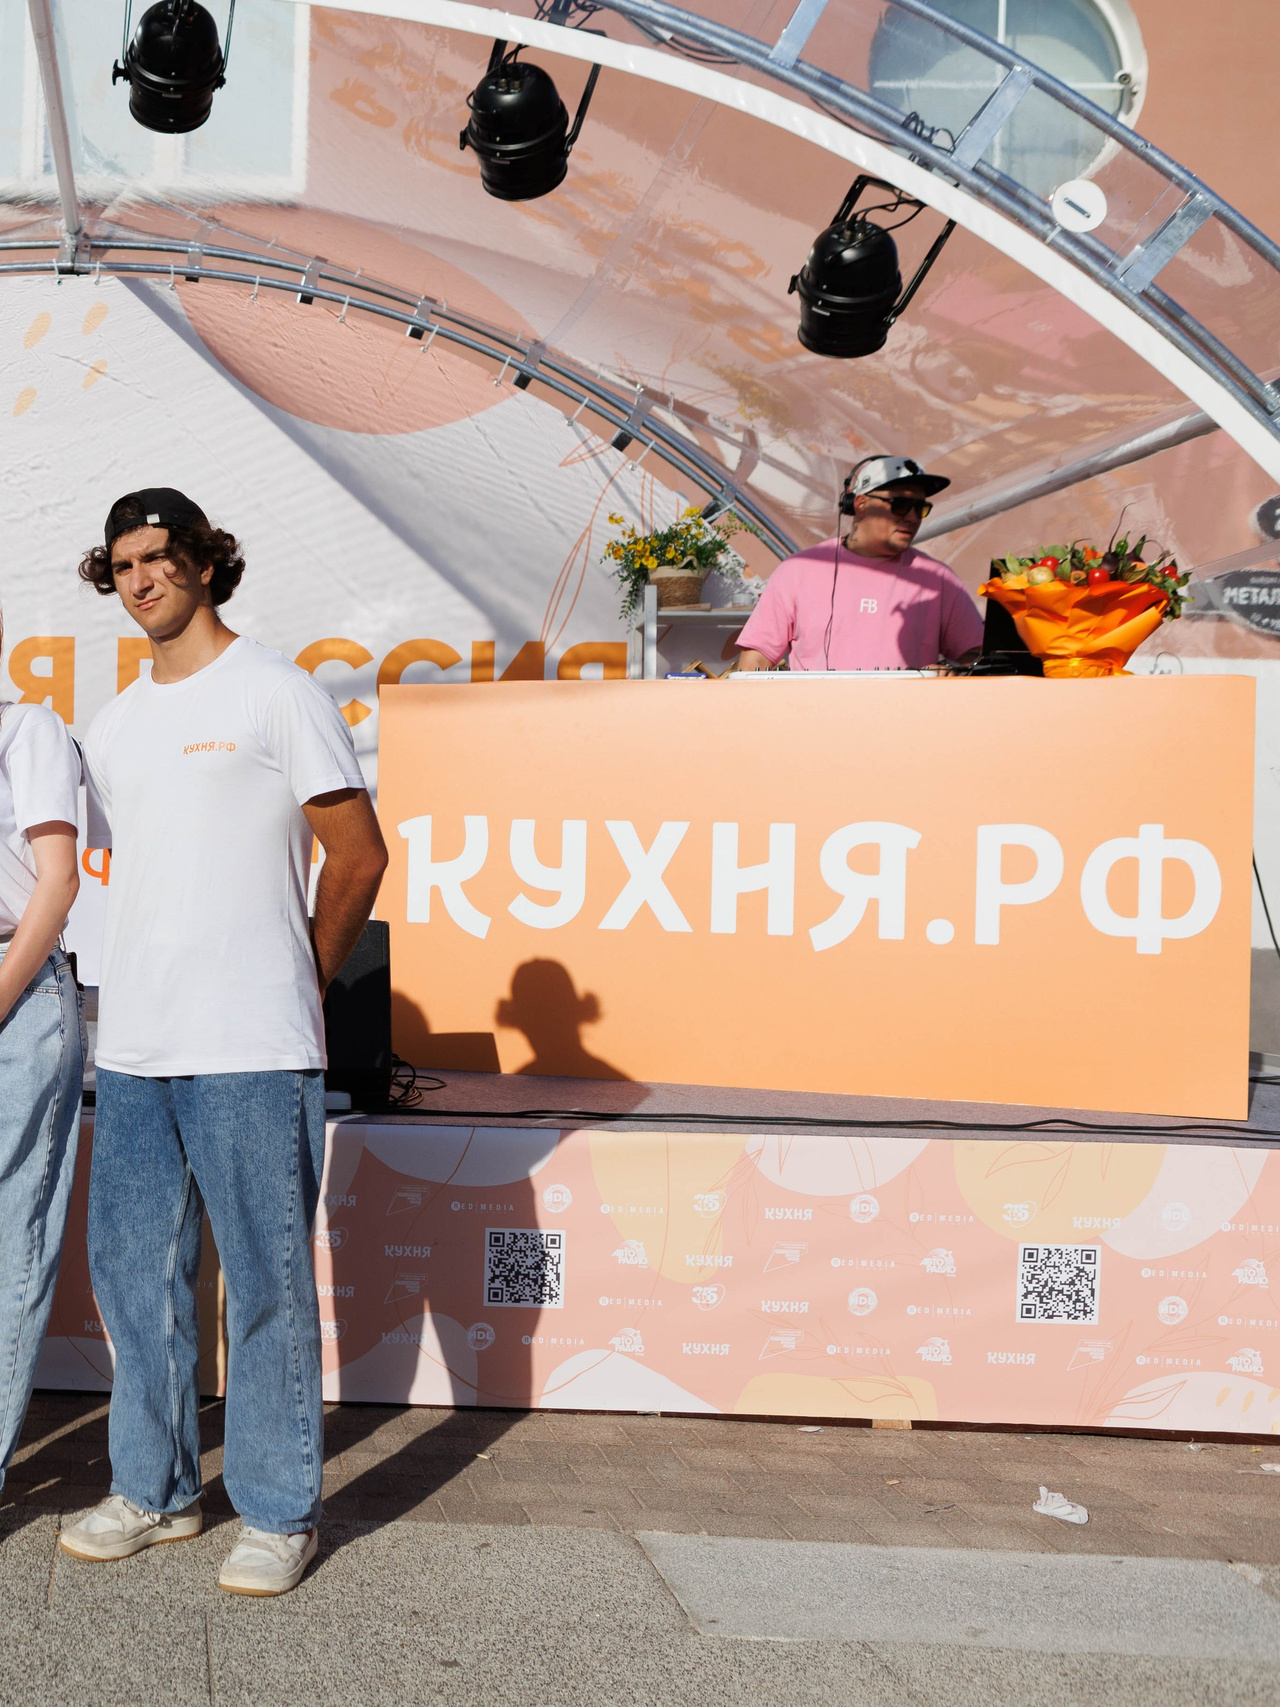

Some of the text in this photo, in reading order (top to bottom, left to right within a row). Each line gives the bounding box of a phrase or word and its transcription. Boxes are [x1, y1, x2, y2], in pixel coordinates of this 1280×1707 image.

[183, 741, 236, 755] КУХНЯ.РФ
[397, 814, 1223, 955] КУХНЯ.РФ
[764, 1207, 813, 1220] КУХНЯ
[1072, 1216, 1122, 1230] КУХНЯ
[1251, 1224, 1279, 1233] MEDI
[384, 1245, 431, 1258] КУХНЯ
[685, 1254, 733, 1267] КУХНЯ
[319, 1285, 355, 1297] УХНЯ
[761, 1300, 810, 1314] КУХНЯ
[1249, 1319, 1278, 1327] MEDI
[382, 1333, 428, 1345] КУХНЯ
[682, 1343, 730, 1356] КУХНЯ
[987, 1351, 1036, 1365] КУХНЯ
